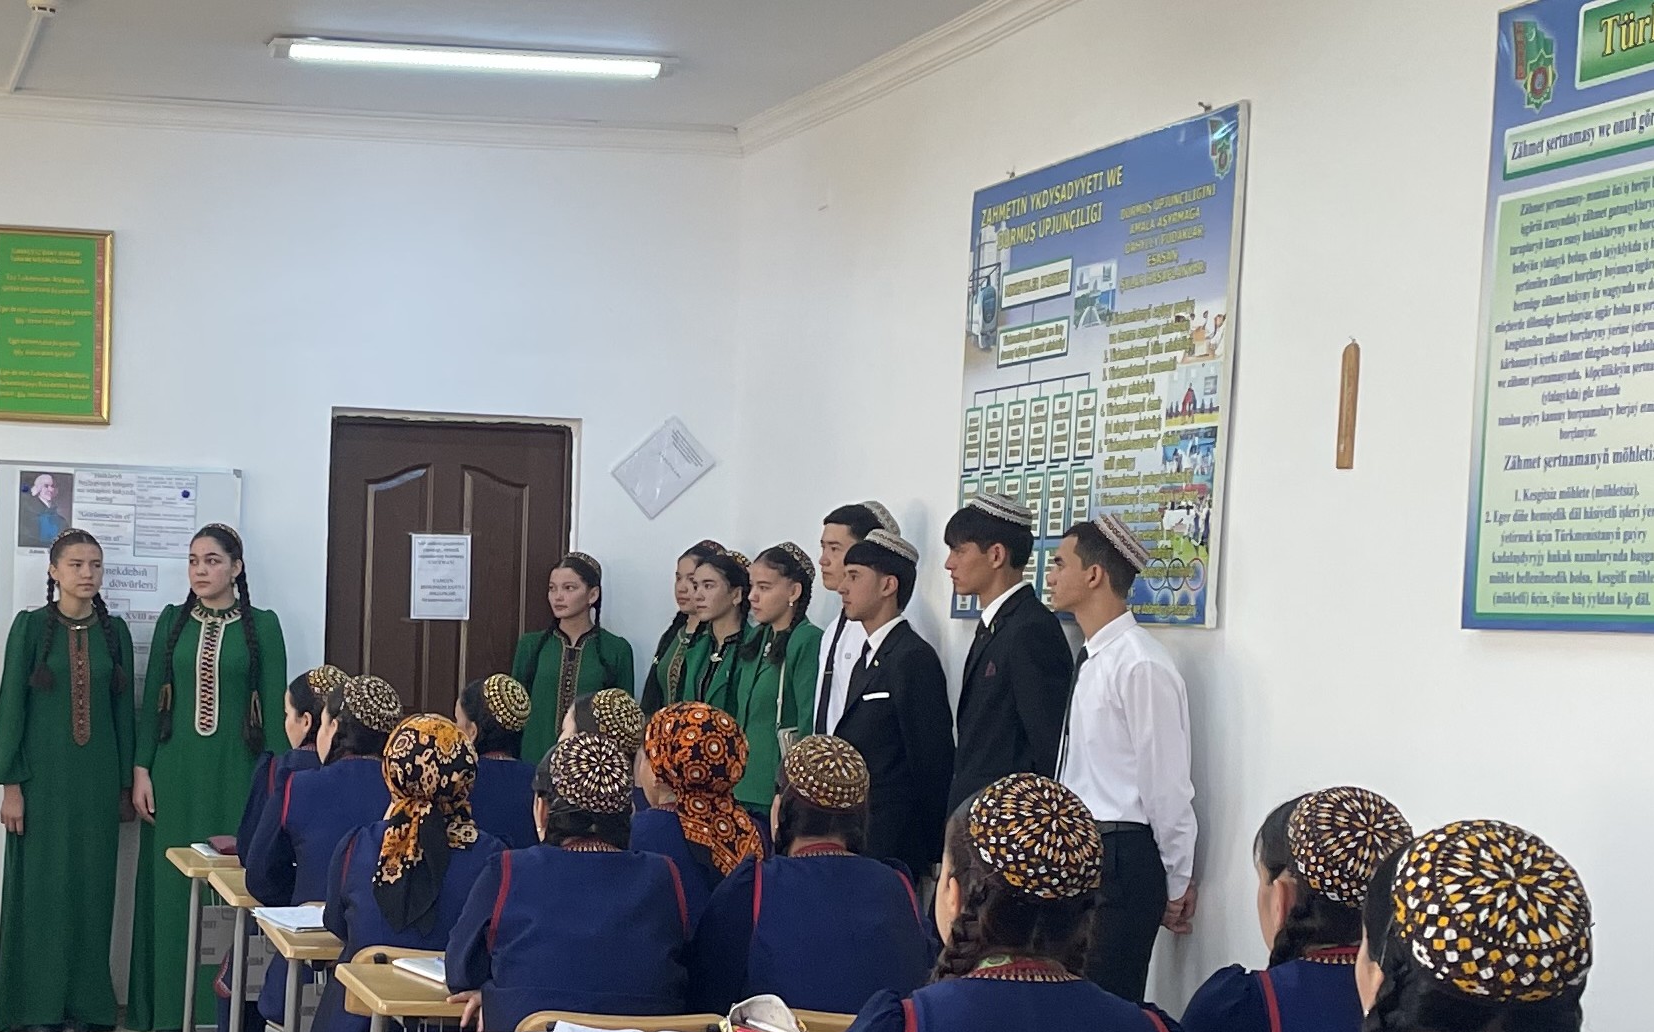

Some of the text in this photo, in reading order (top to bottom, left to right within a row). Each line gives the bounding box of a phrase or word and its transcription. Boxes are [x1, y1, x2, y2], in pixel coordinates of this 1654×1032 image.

[1511, 140, 1544, 161] Zähmet
[1598, 123, 1612, 138] we
[1106, 165, 1124, 189] WE
[1504, 454, 1542, 472] Zähmet
